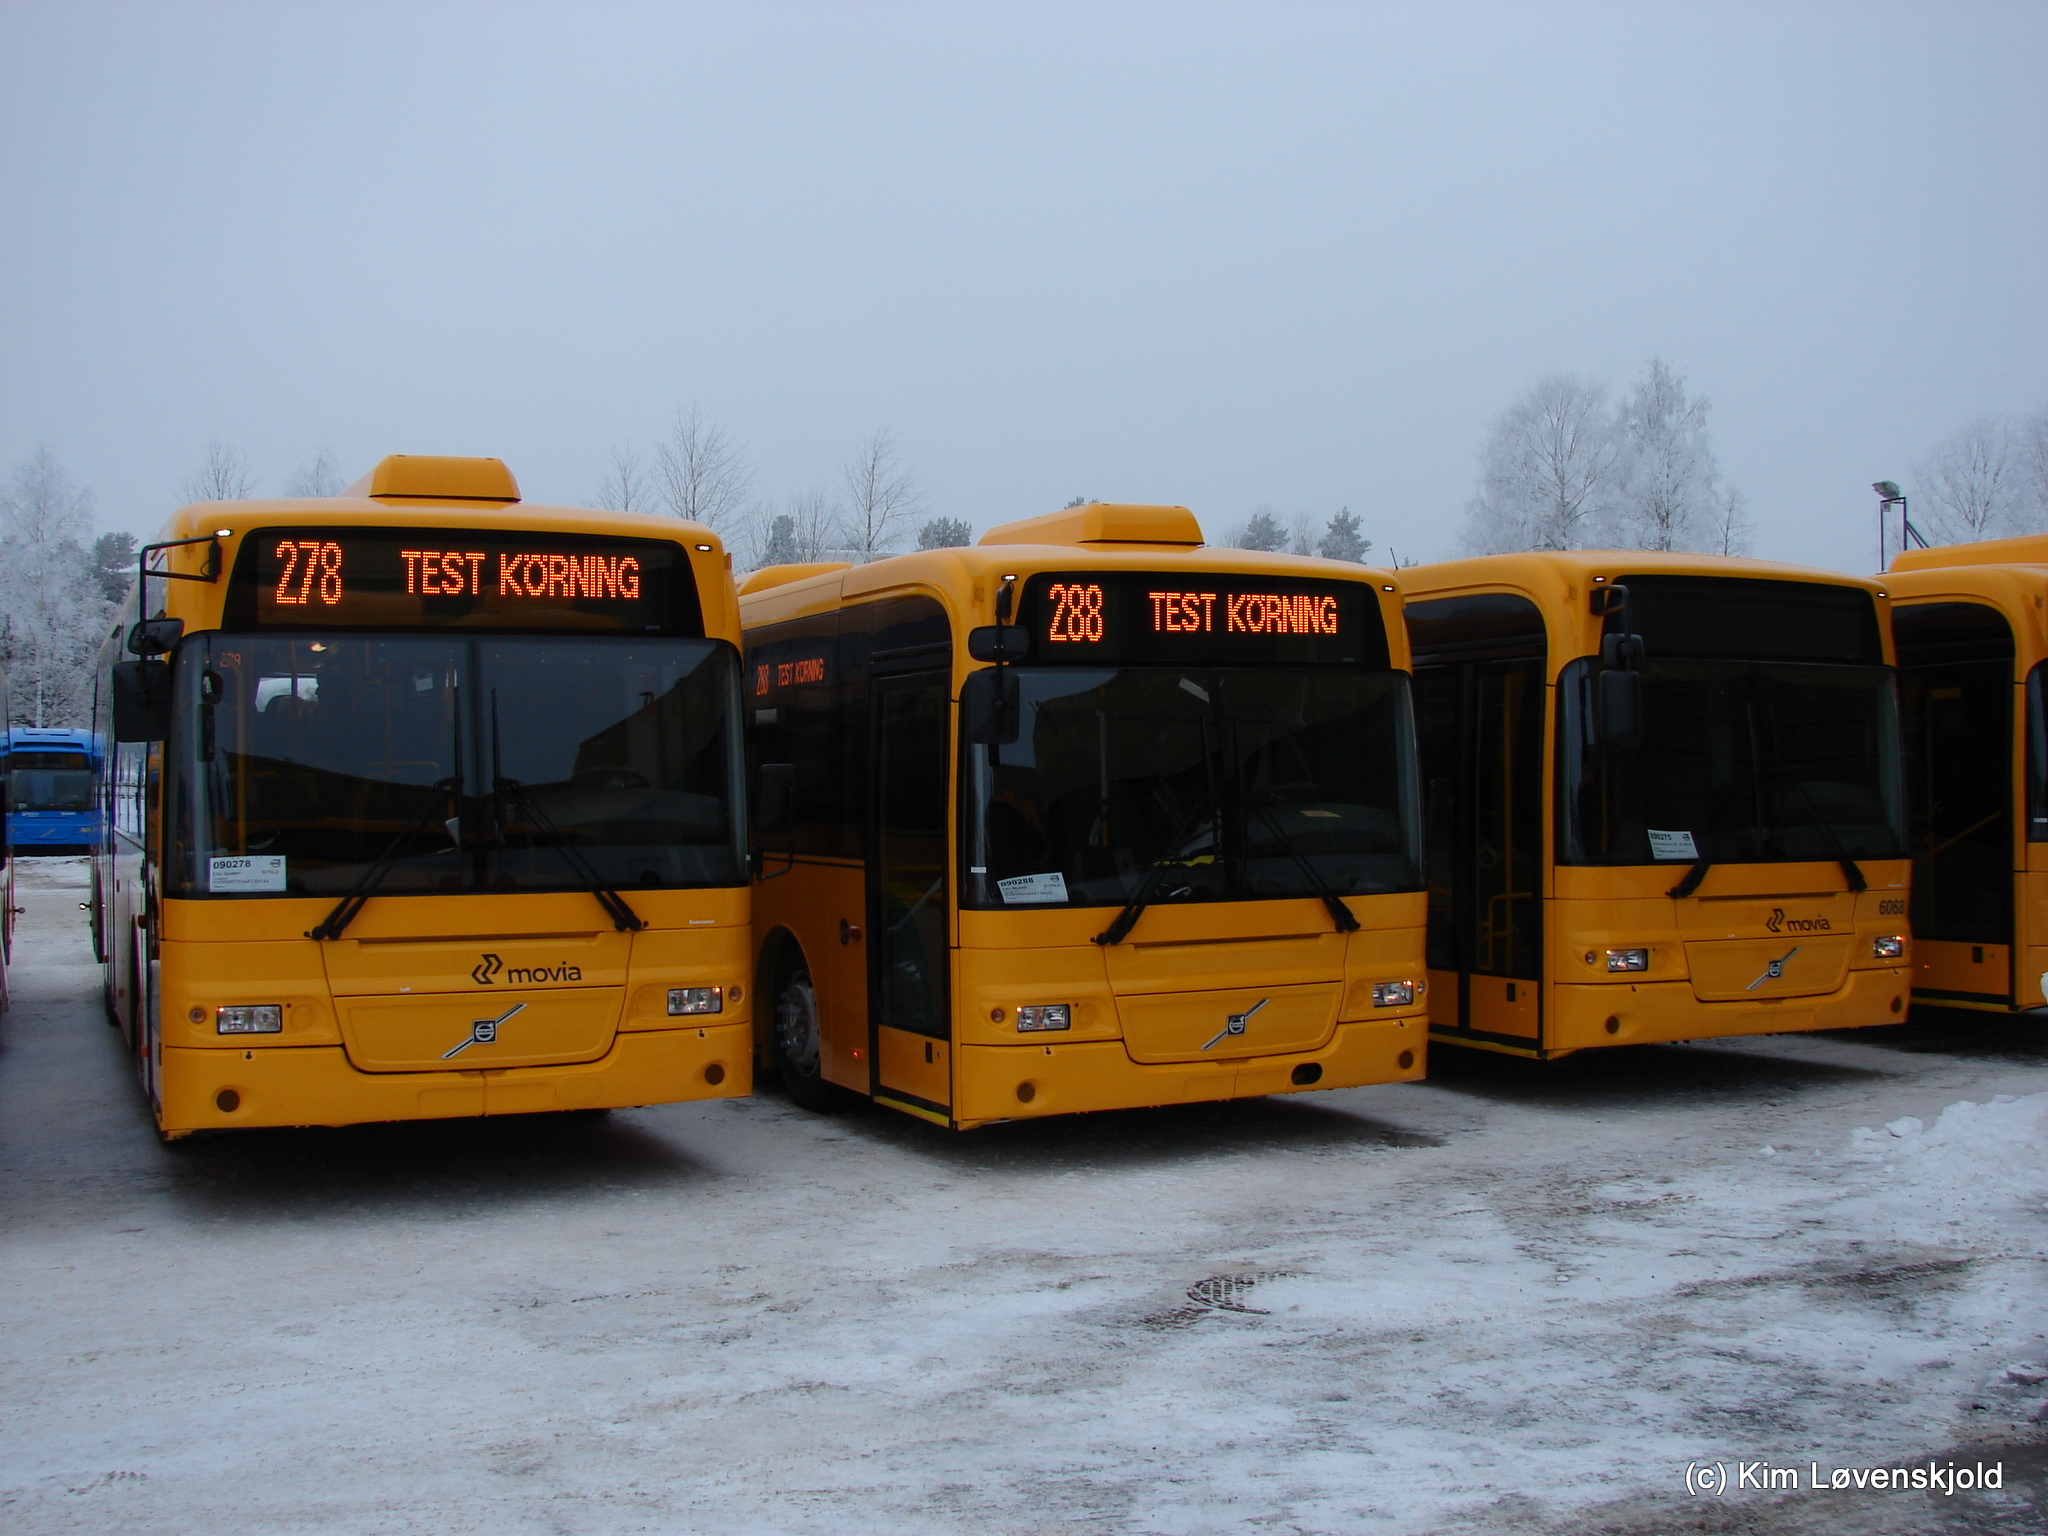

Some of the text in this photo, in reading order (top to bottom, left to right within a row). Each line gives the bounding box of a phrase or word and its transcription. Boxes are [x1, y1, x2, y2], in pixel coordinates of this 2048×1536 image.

[276, 541, 639, 604] 278 TEST KÖRNING
[1050, 584, 1337, 641] 288 TEST KÖRNING
[778, 663, 794, 687] TEST
[795, 658, 824, 684] KÖRNING
[213, 860, 251, 869] 090278
[1001, 877, 1034, 887] 090288
[1787, 914, 1831, 932] movia
[508, 961, 583, 983] movia
